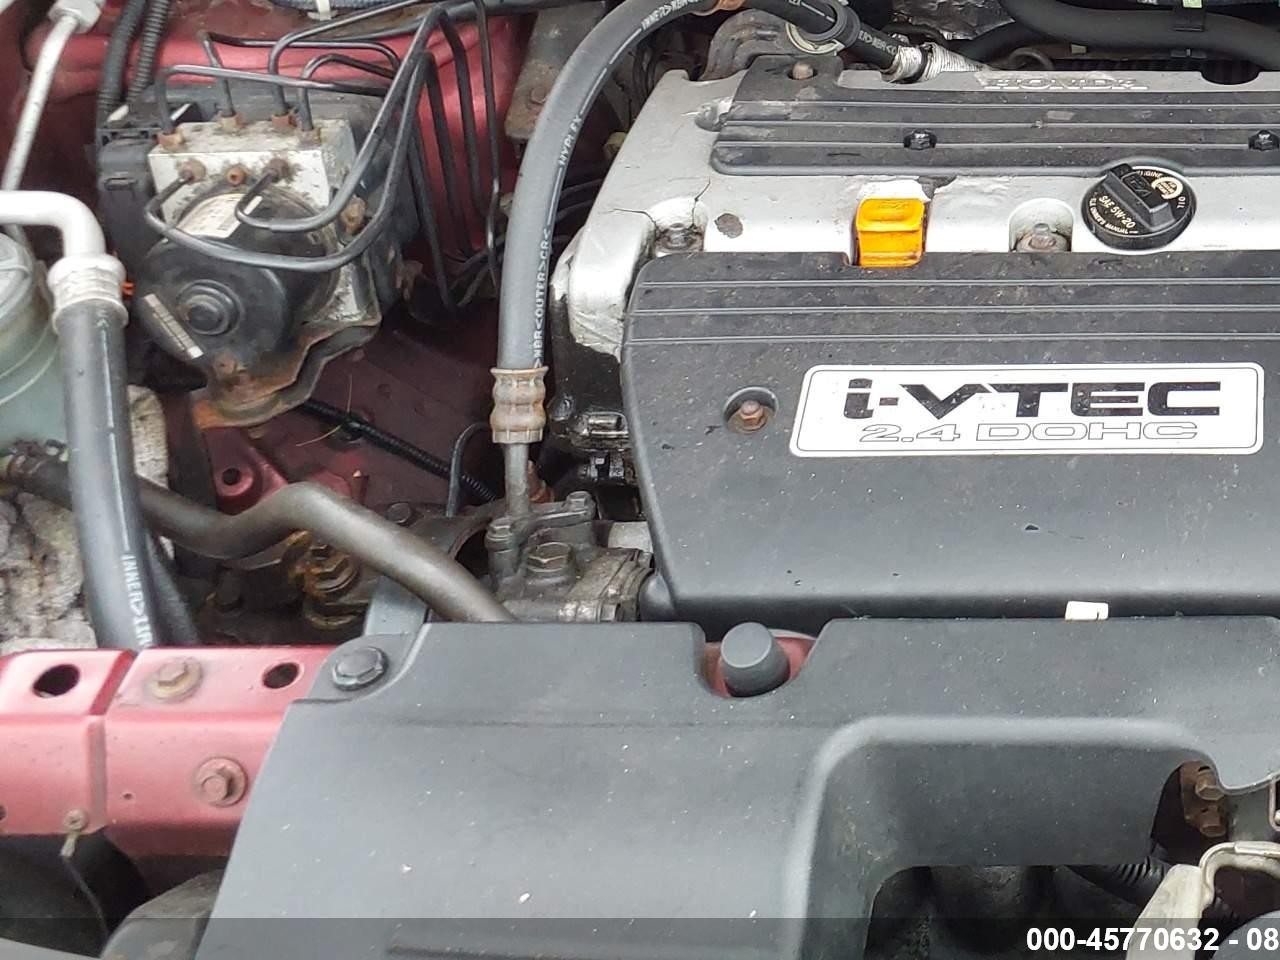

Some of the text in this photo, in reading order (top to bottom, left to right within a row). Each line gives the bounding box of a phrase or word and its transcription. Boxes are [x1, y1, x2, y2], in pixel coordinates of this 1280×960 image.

[1099, 195, 1136, 229] SAE 5W-20
[1176, 196, 1186, 209] OIL
[843, 378, 1221, 420] i-VTEC
[859, 422, 1198, 442] 2.4 DOHC
